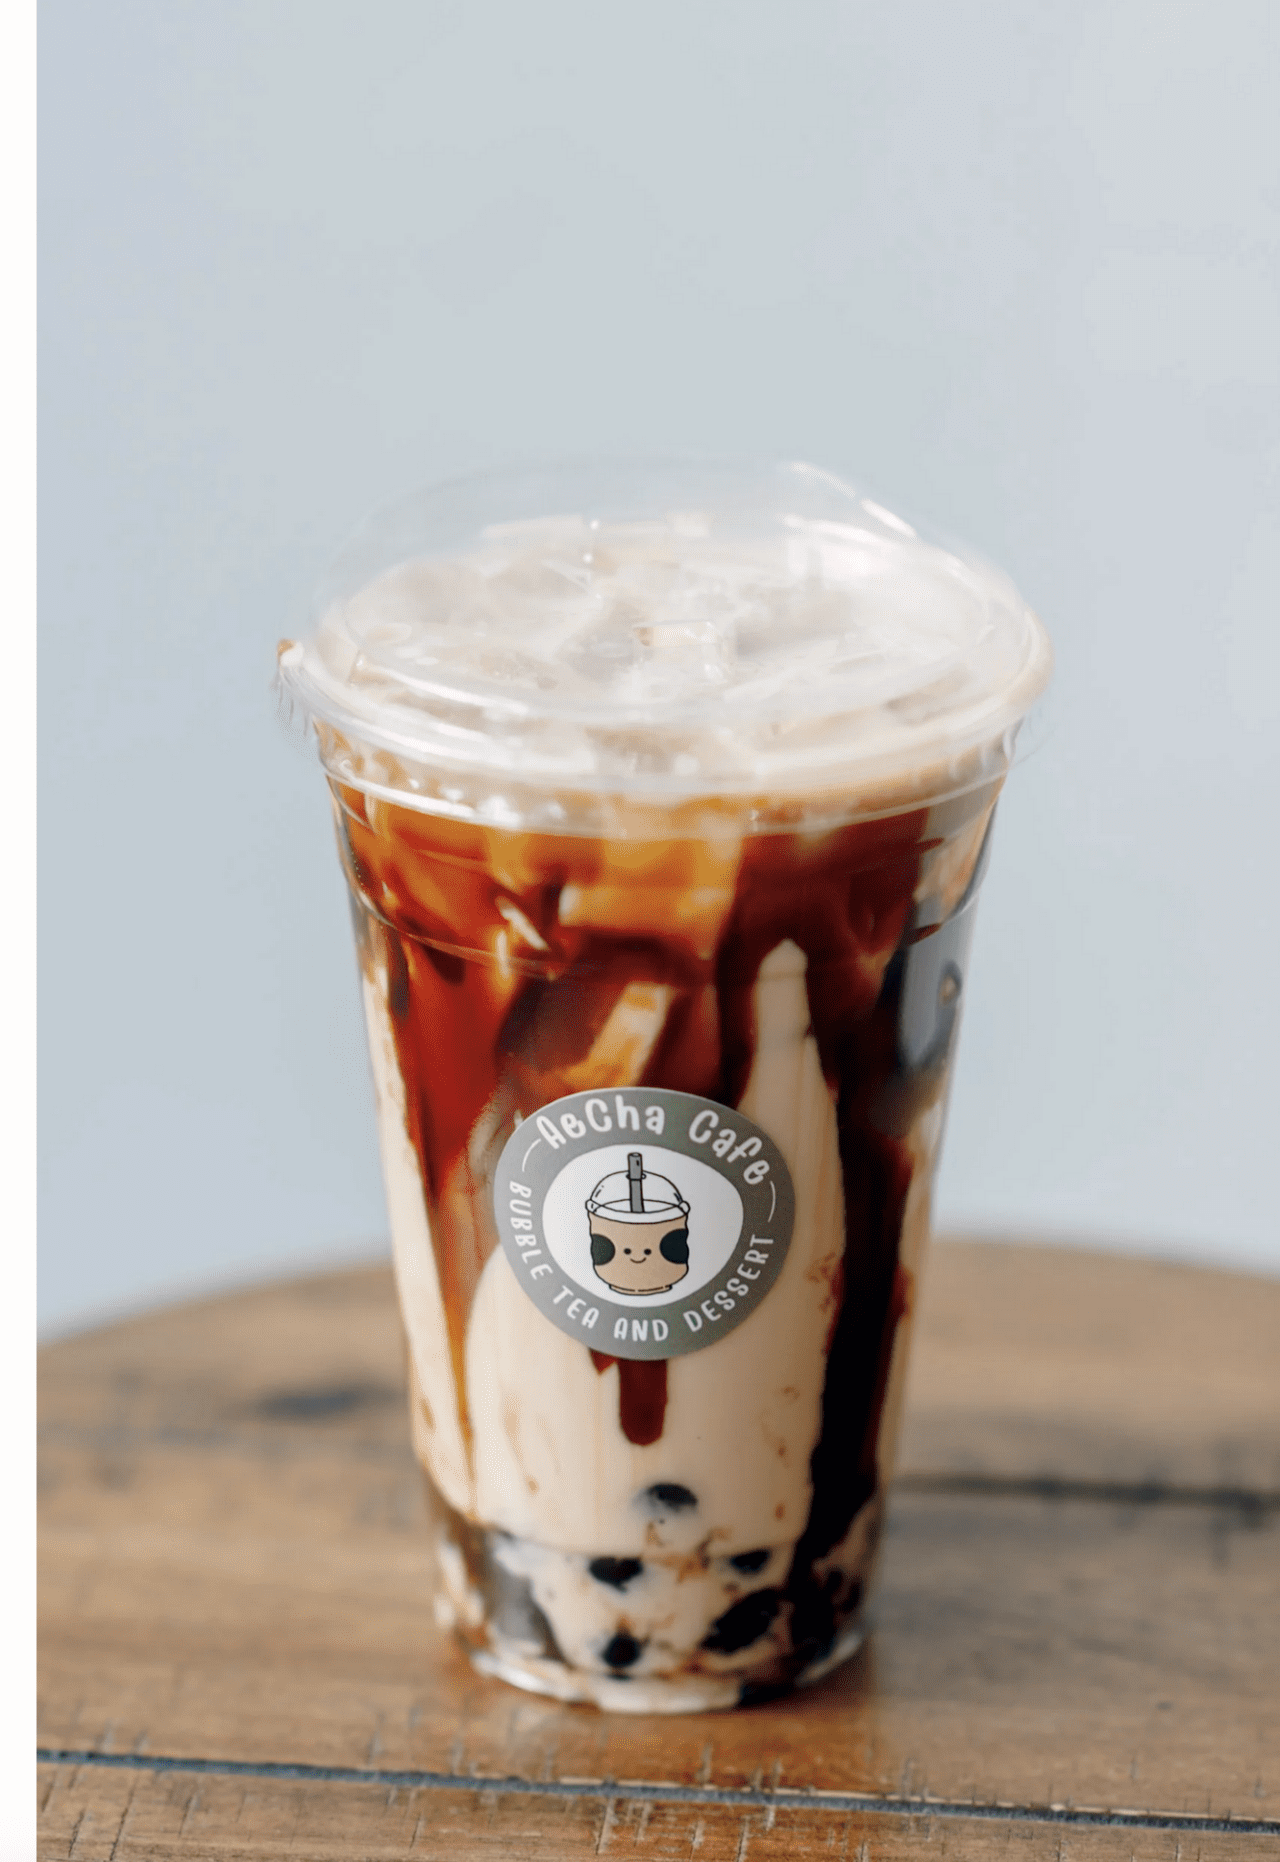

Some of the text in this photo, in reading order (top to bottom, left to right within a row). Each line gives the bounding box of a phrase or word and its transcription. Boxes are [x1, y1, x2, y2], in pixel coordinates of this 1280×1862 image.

[688, 1109, 771, 1186] Cafe
[508, 1179, 774, 1342] BUBBLE TEA AND DESSERT
